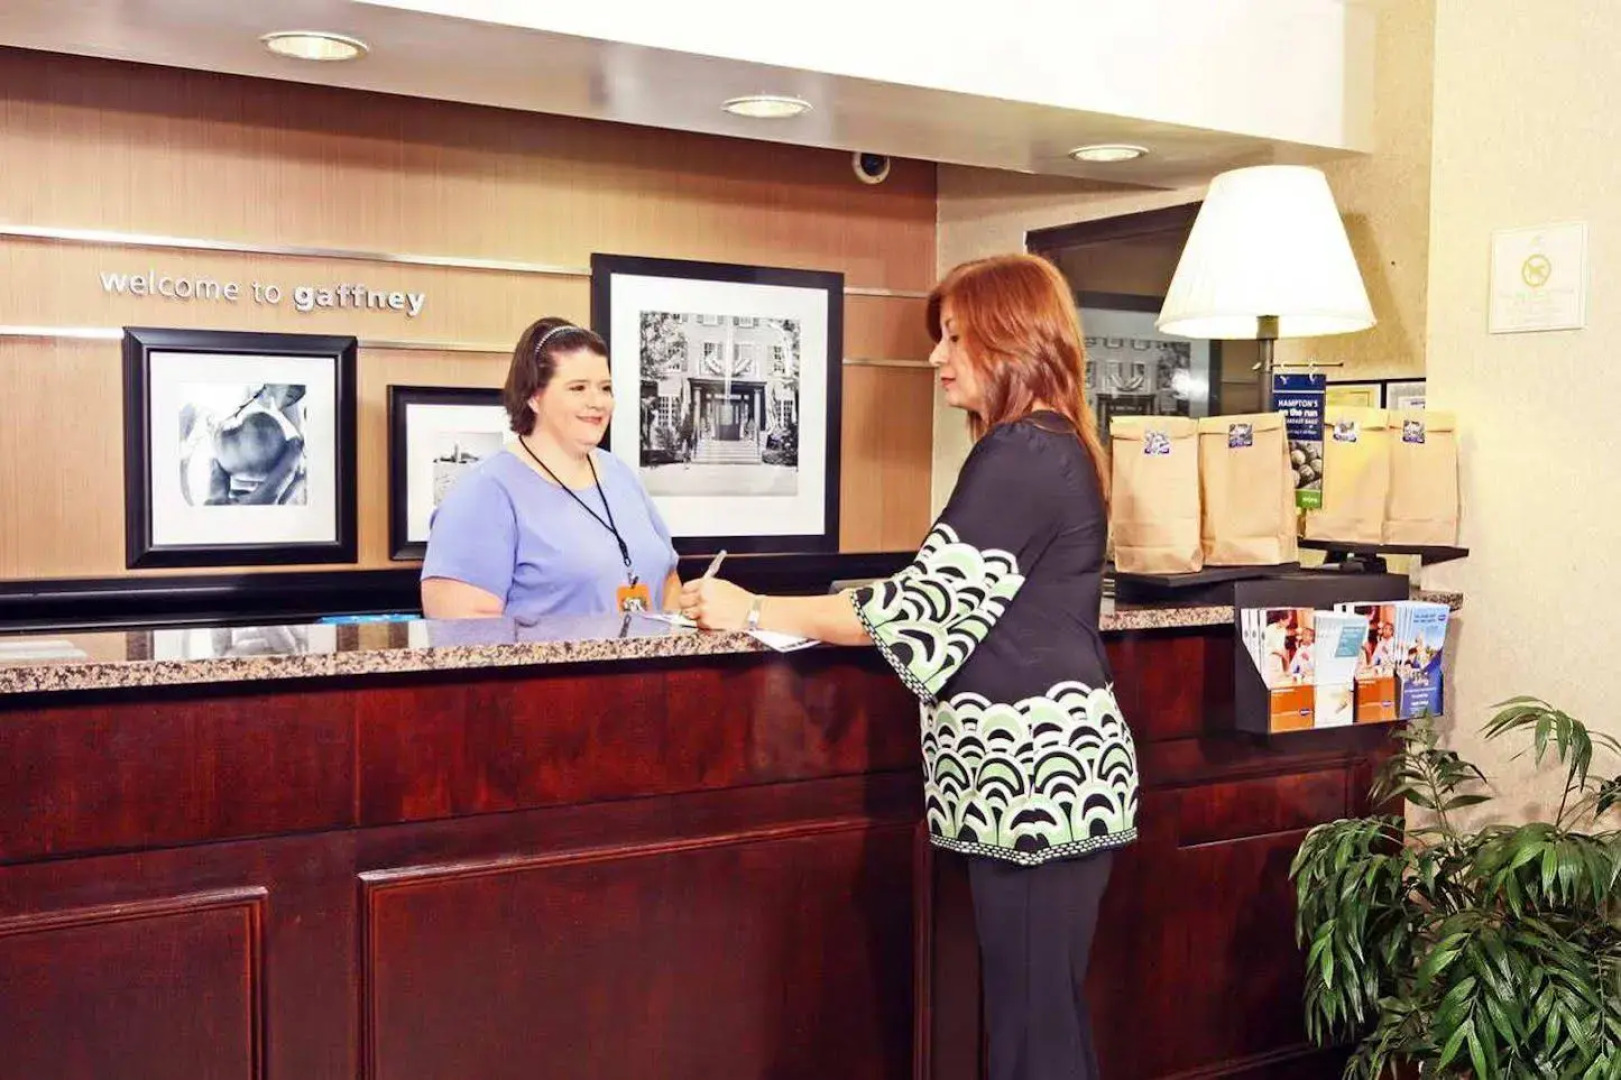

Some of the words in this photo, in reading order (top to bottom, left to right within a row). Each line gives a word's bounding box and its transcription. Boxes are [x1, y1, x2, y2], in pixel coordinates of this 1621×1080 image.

[100, 270, 240, 302] welcome
[252, 279, 281, 305] to
[294, 283, 426, 317] gaffney
[1278, 399, 1318, 407] HAMPTON'S
